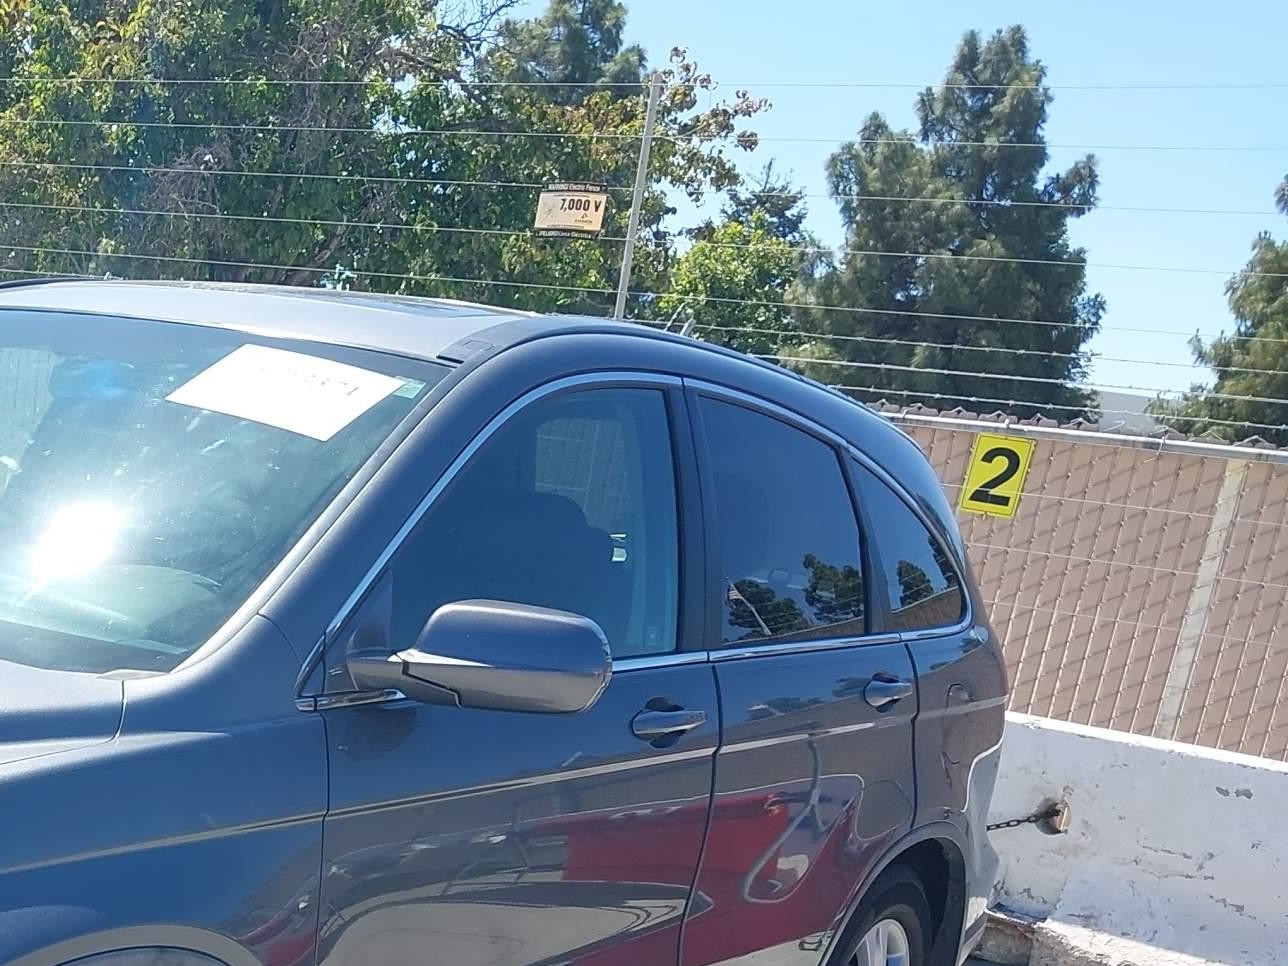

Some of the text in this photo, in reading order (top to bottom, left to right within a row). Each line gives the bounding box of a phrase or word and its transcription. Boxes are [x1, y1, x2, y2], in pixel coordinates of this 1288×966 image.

[560, 199, 602, 213] 7,000 V
[968, 447, 1020, 507] 2
